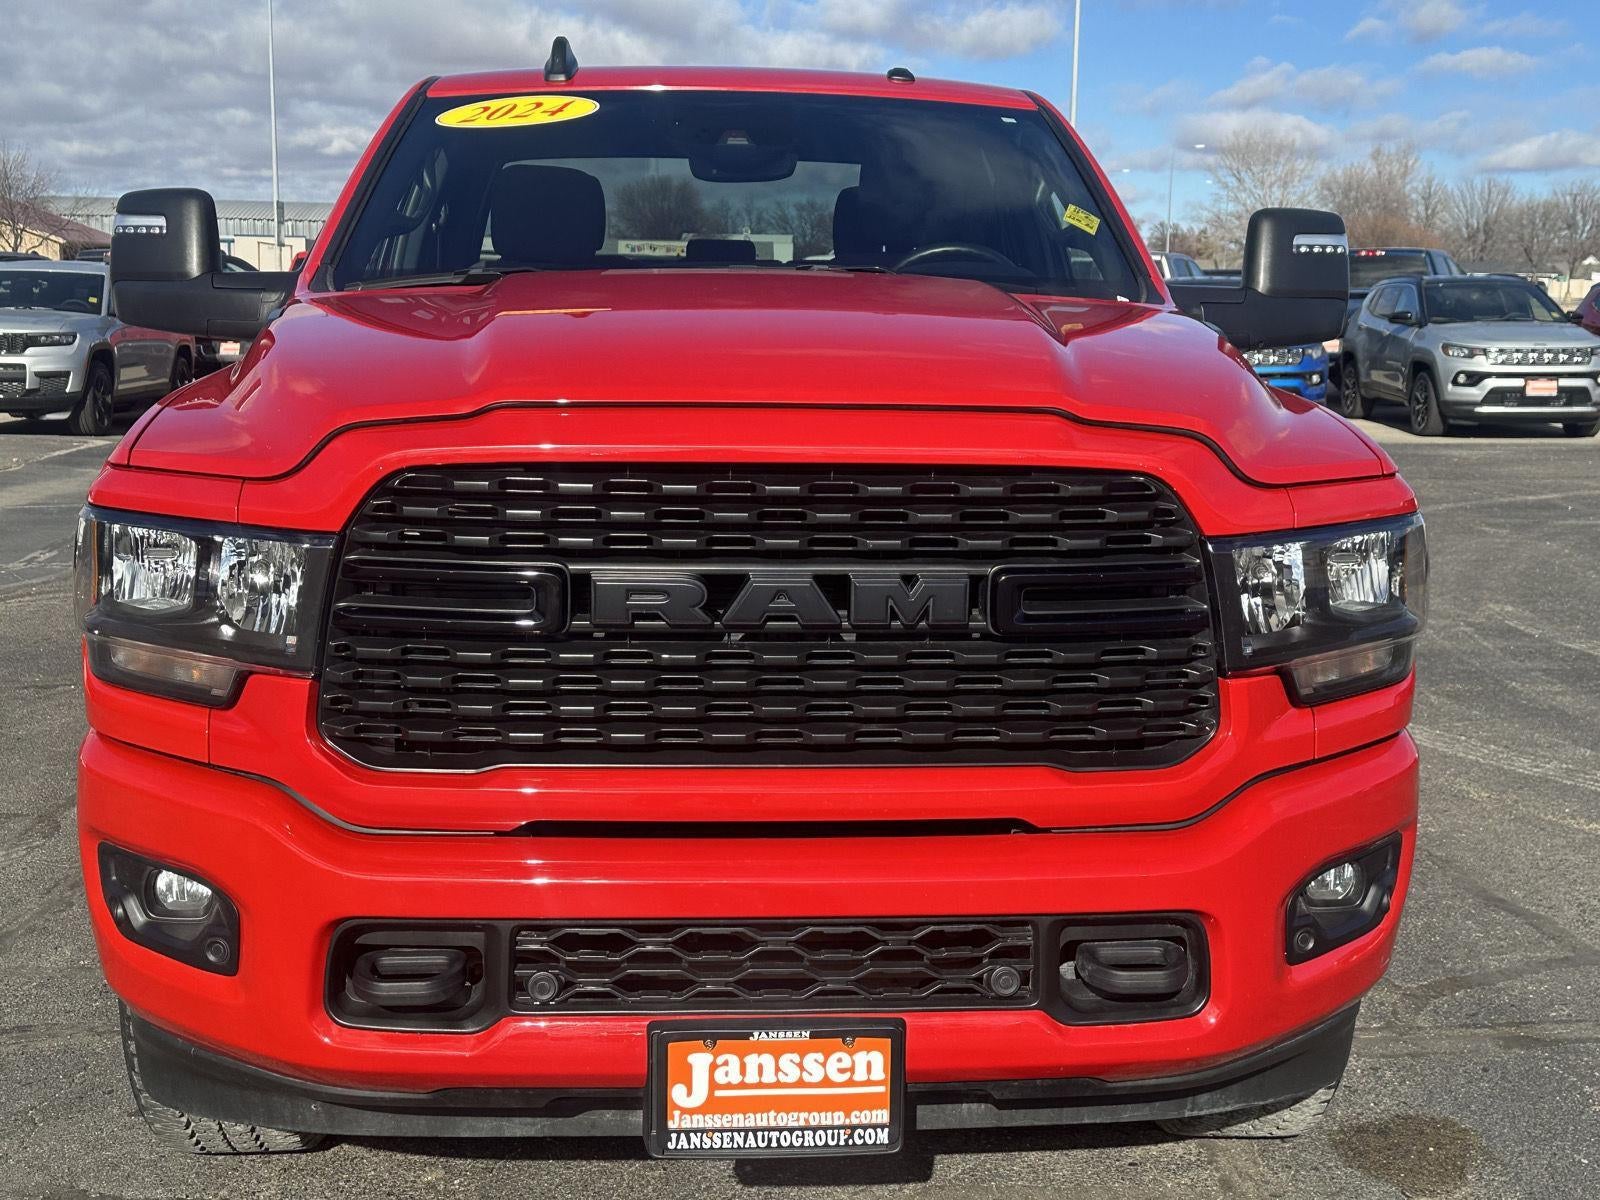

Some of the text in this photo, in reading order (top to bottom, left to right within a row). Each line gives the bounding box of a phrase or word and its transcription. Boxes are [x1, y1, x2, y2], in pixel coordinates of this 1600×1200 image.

[456, 100, 576, 123] 2024
[589, 571, 969, 629] RAM
[750, 1031, 810, 1040] JANSSEN
[671, 1050, 886, 1108] Janssen
[668, 1108, 888, 1128] Janssenautogroup.com
[667, 1128, 889, 1149] JANSSENAUTOGROUP.COM
